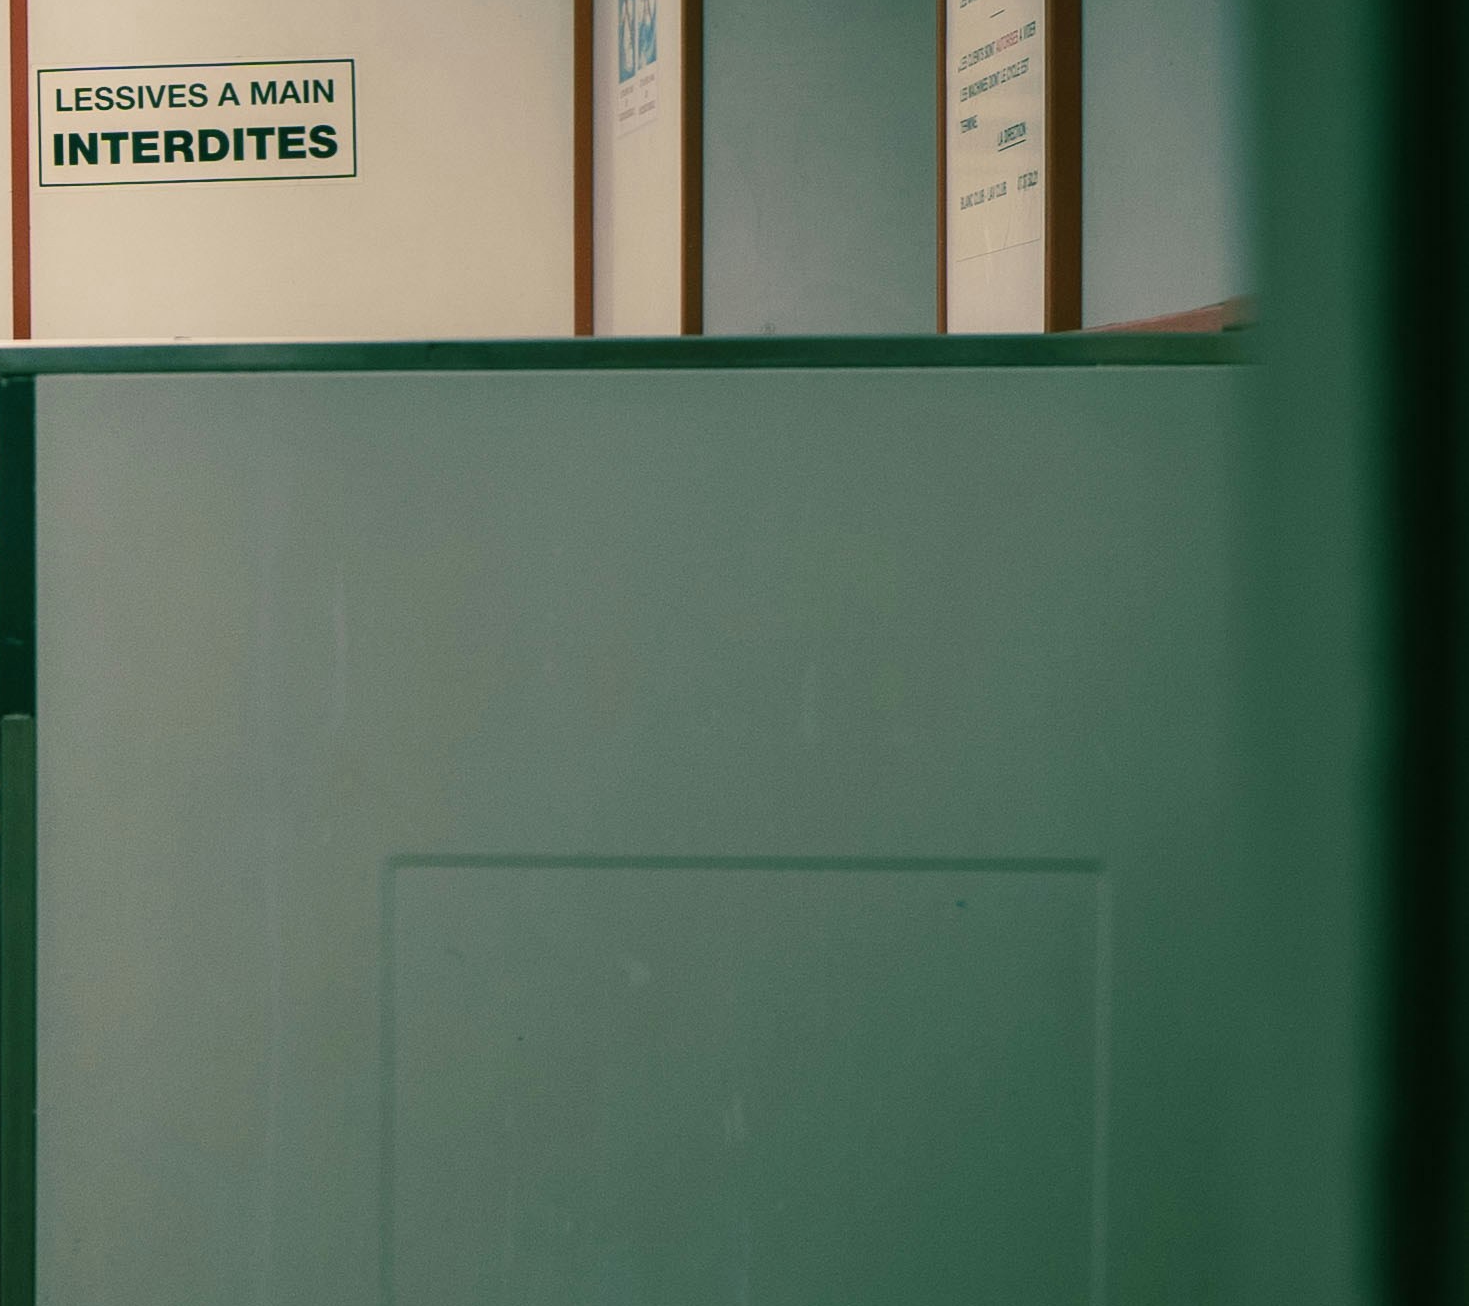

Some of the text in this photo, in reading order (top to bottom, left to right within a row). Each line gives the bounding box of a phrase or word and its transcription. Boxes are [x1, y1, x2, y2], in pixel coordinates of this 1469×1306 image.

[55, 79, 334, 112] LESSIVES A MAIN
[53, 125, 338, 166] INTERDITES
